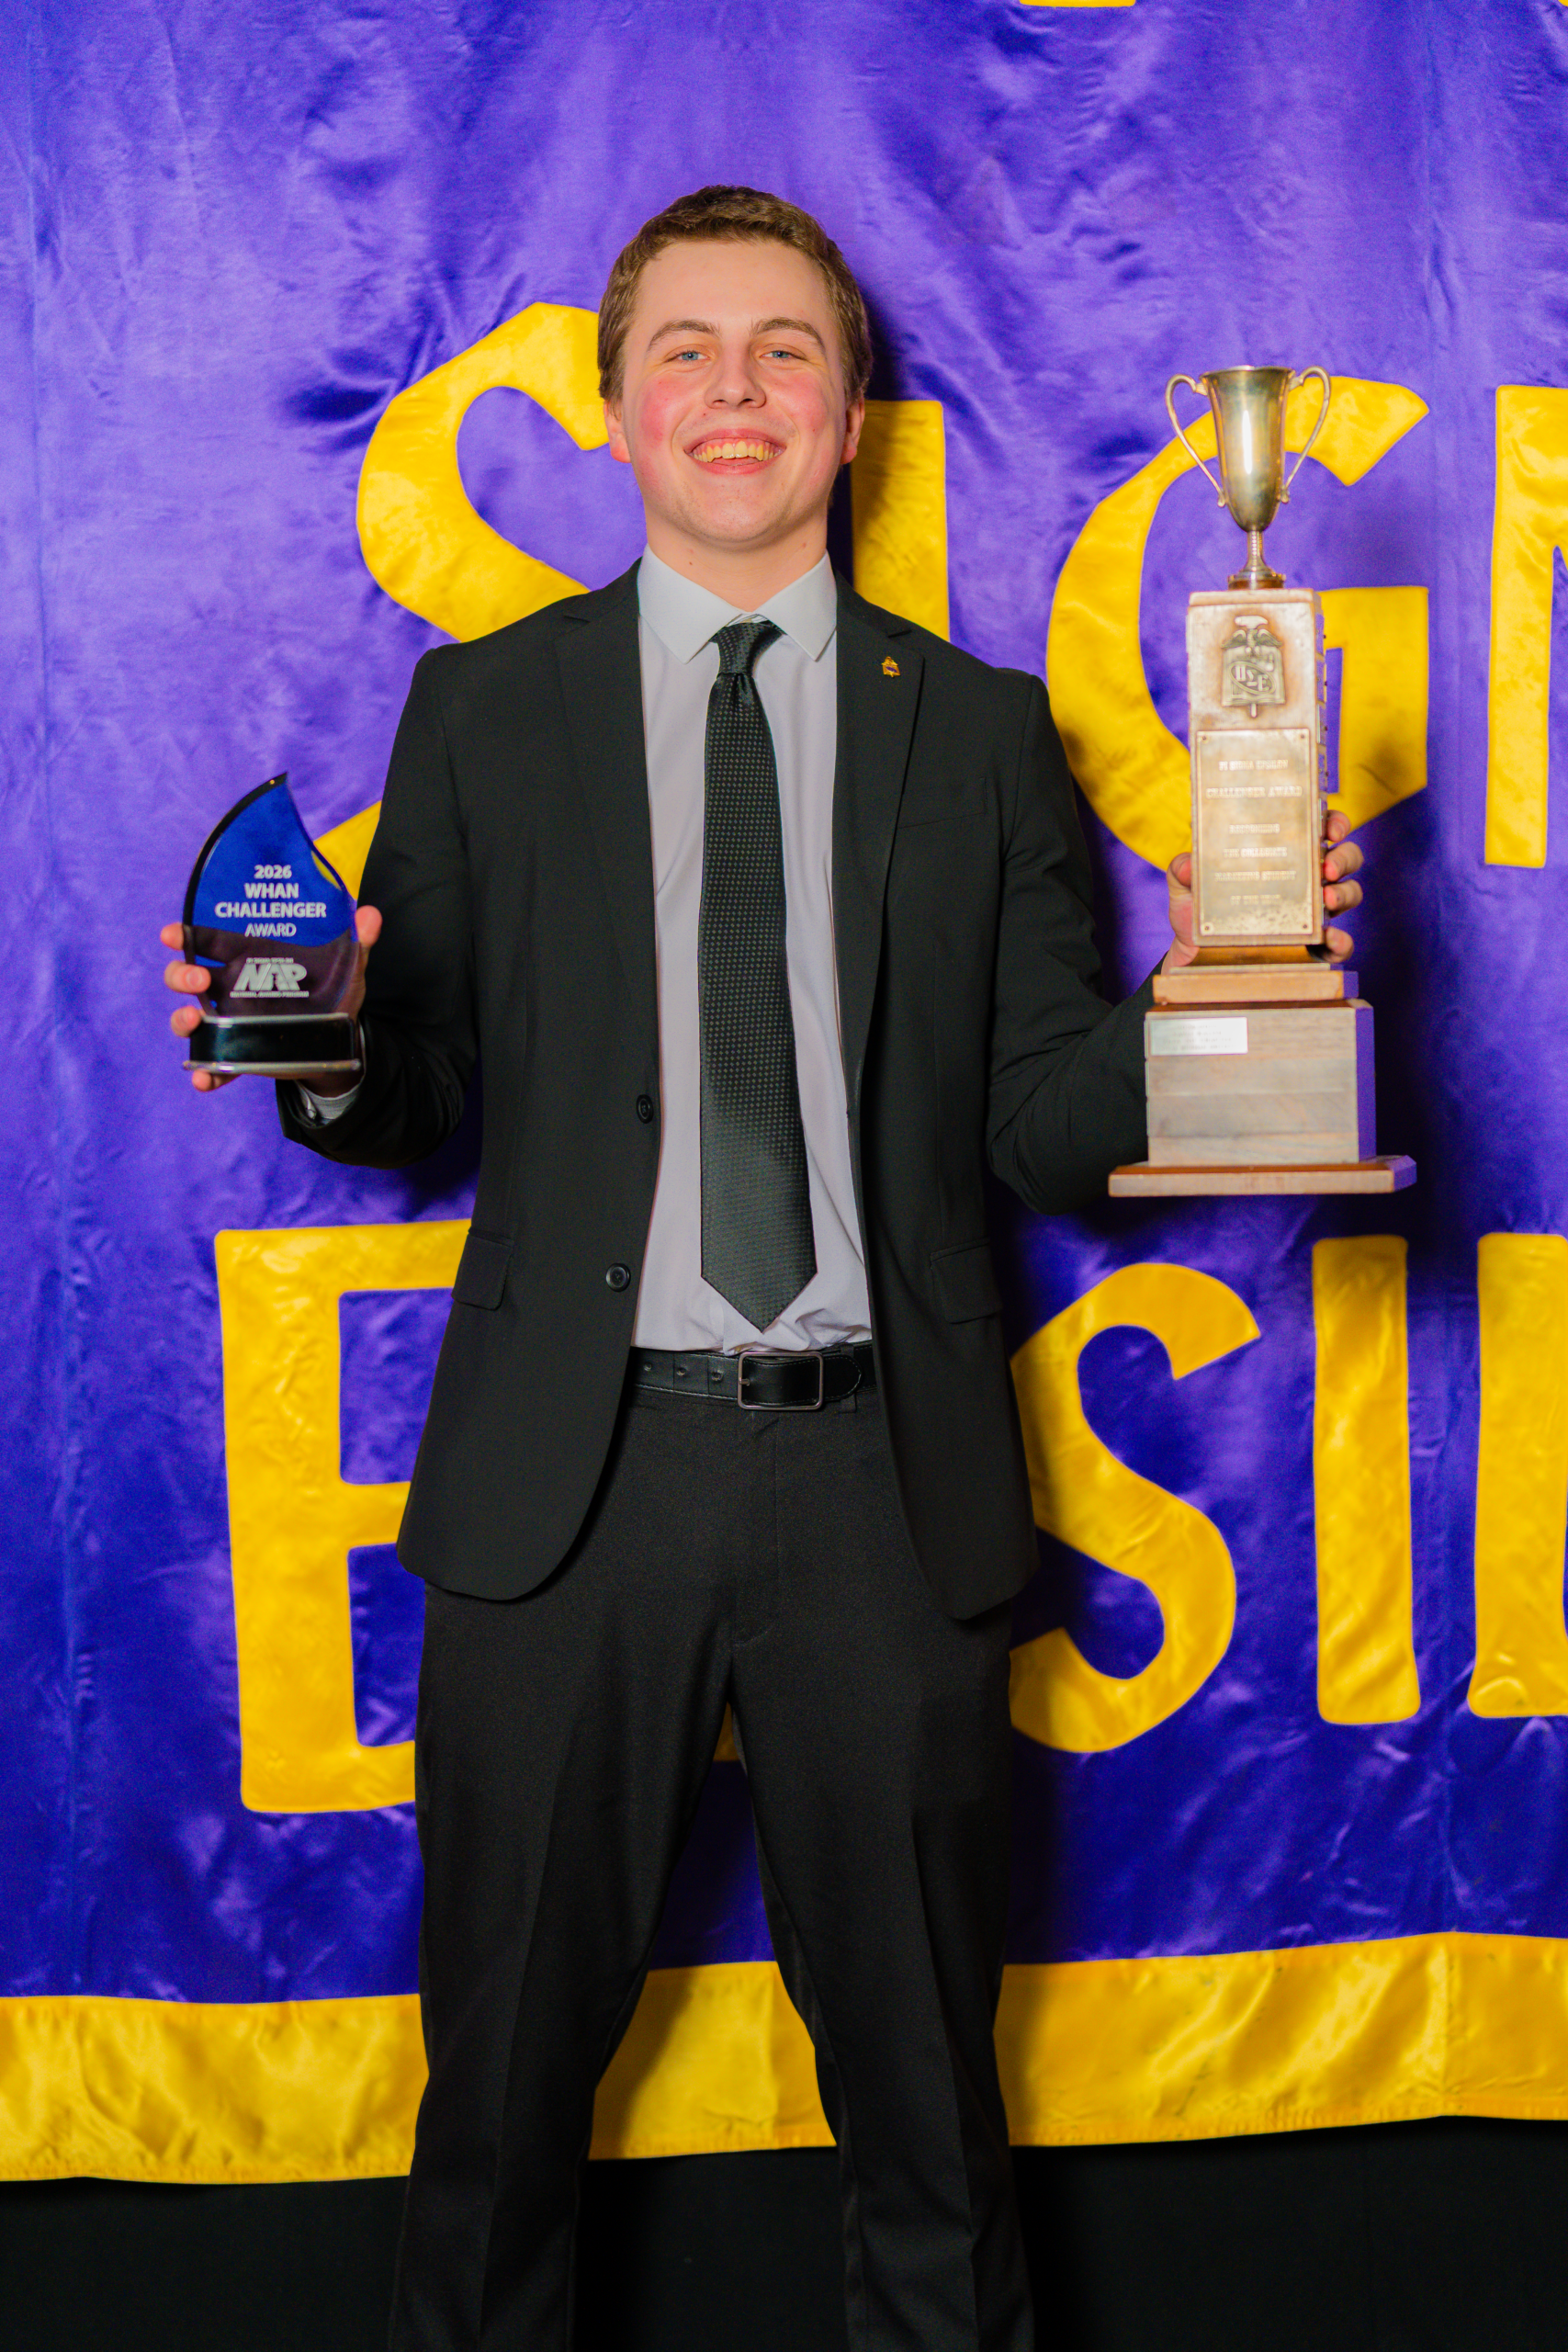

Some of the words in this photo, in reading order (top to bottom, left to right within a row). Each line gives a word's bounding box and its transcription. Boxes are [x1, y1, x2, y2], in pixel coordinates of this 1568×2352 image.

[1205, 786, 1266, 799] CHALLENGER
[1268, 786, 1303, 797] AWARD
[254, 864, 292, 879] 2026
[243, 882, 299, 899] WHAN
[214, 901, 327, 918] CHALLENGER
[244, 922, 297, 937] AWARD
